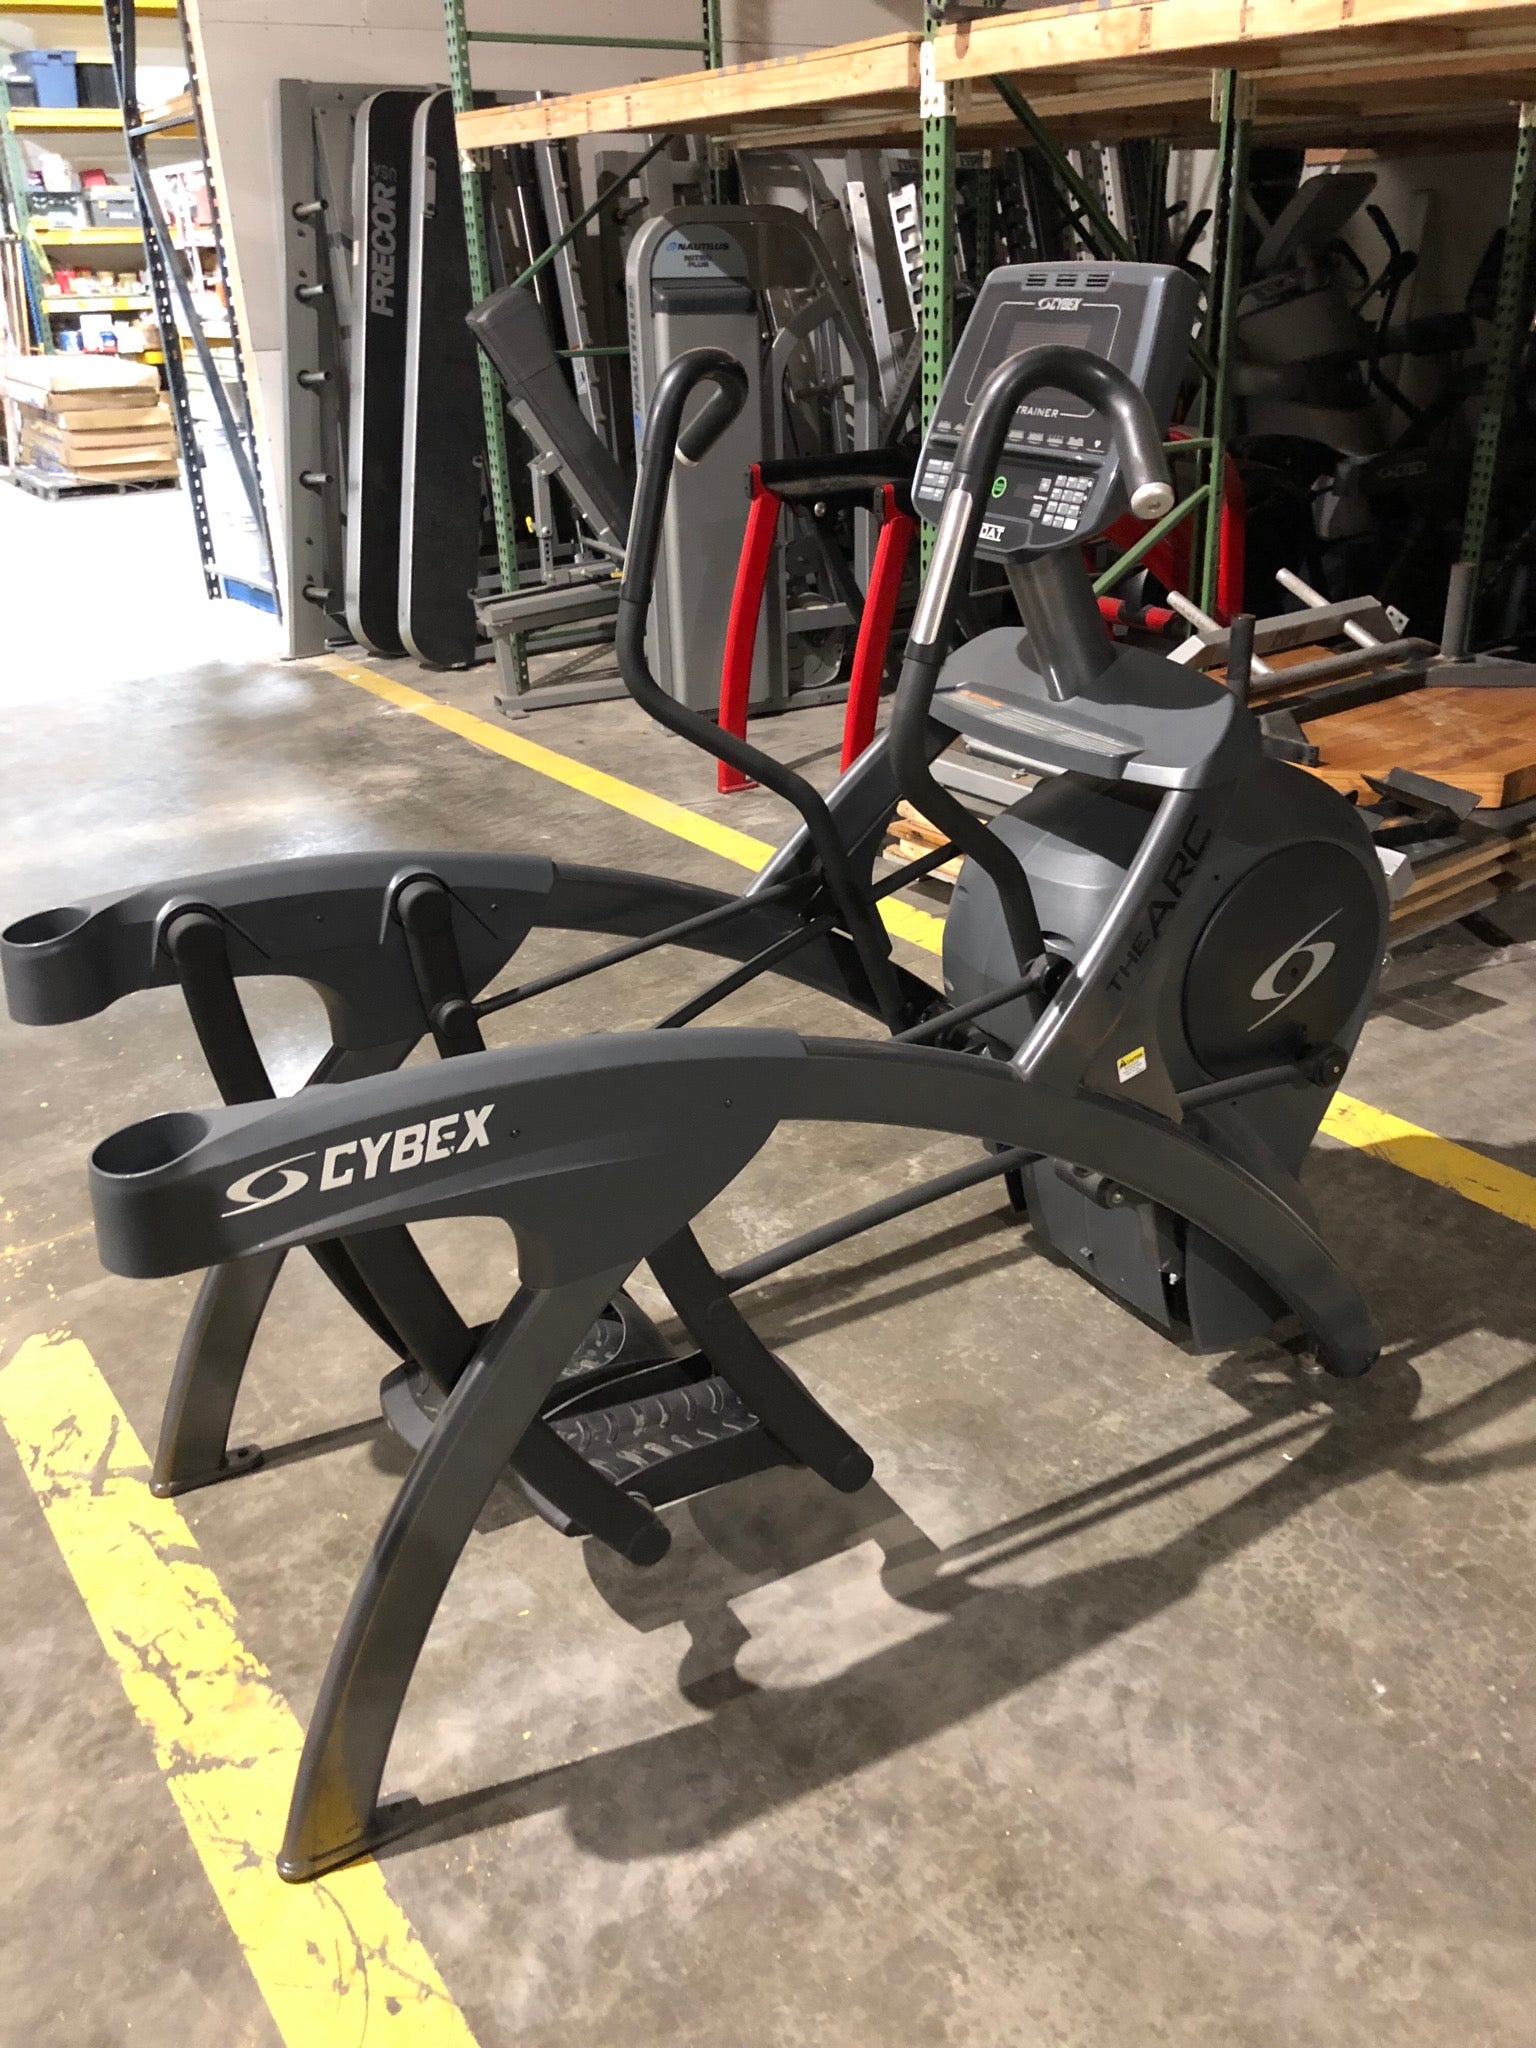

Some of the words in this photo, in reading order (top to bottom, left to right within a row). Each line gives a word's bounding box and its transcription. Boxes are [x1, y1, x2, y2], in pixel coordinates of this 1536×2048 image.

[371, 182, 397, 317] PRECOR
[1048, 297, 1084, 311] CYBEX
[1016, 405, 1059, 418] TRAINER
[1106, 931, 1151, 991] THE
[1149, 814, 1212, 940] ARC
[319, 1104, 495, 1192] CYBEX
